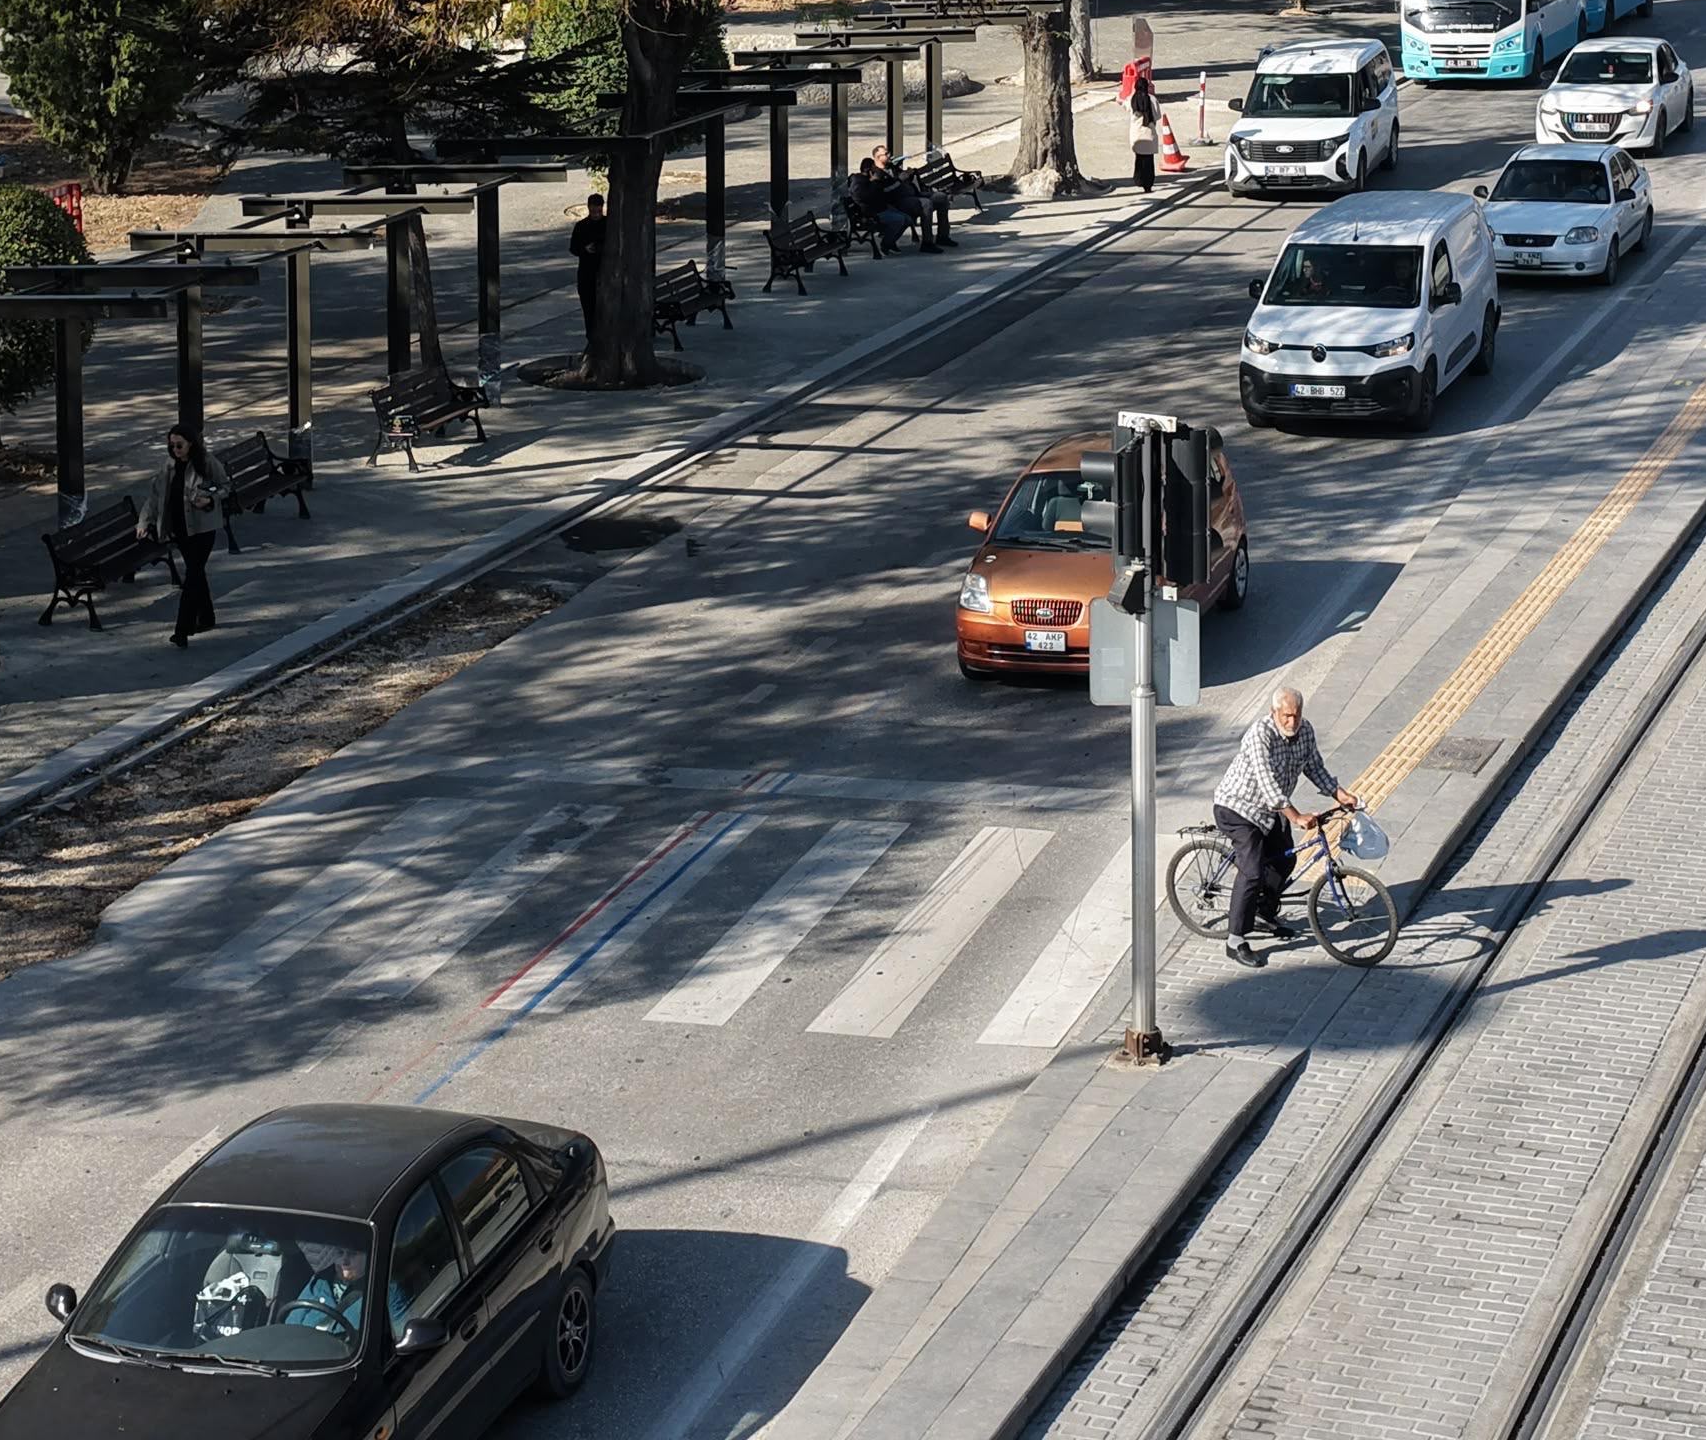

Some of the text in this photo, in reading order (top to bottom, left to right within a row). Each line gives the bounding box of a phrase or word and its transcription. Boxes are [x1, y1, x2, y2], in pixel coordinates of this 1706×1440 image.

[1295, 386, 1344, 396] 42 BHB 522
[1027, 632, 1063, 641] 42 AKP
